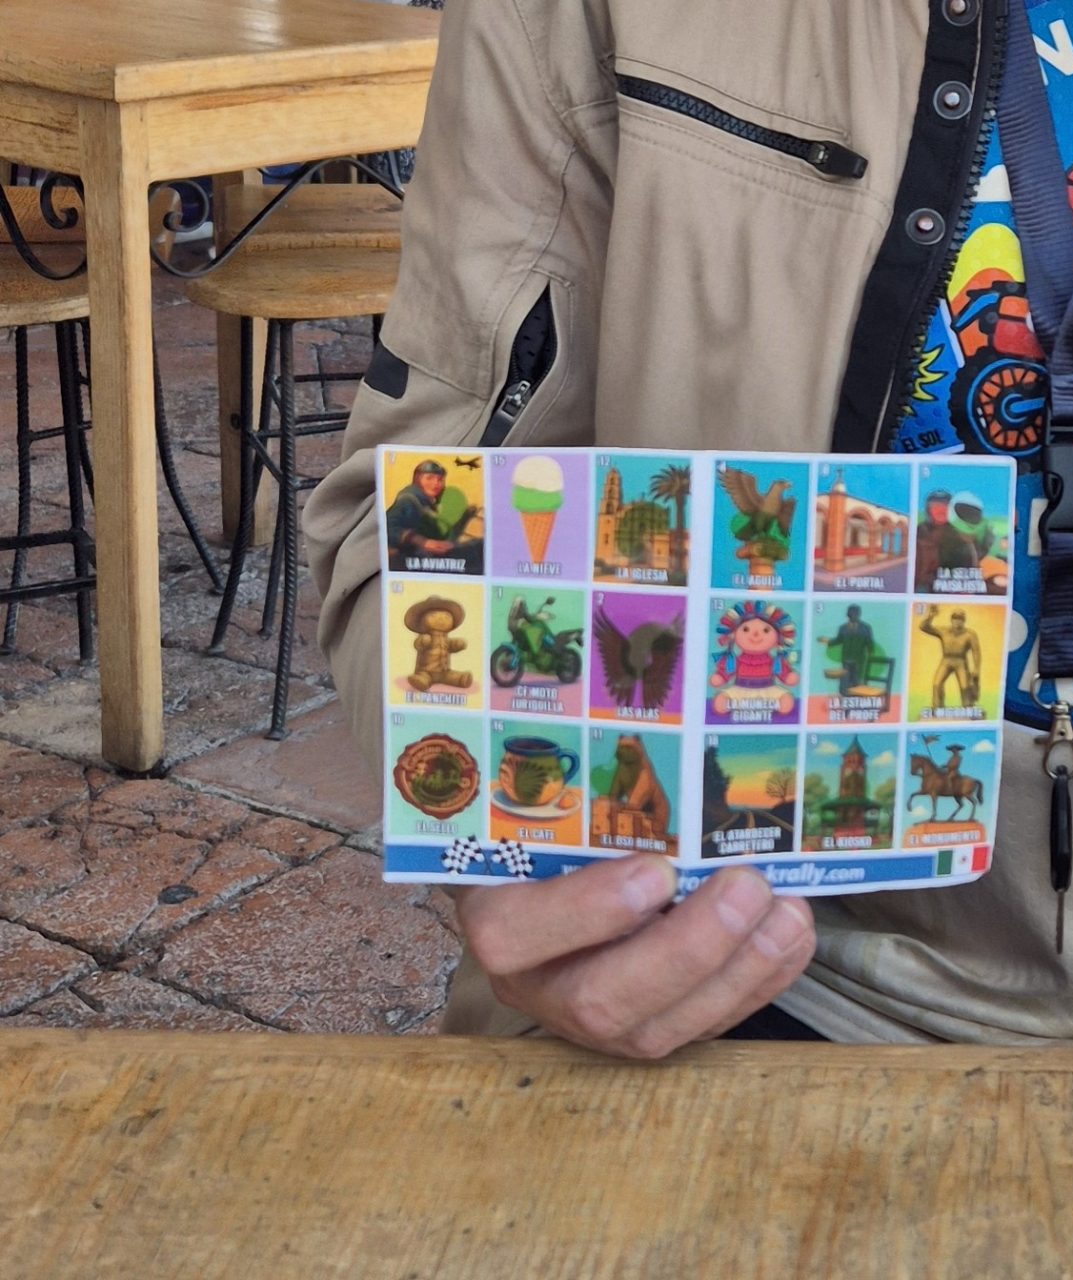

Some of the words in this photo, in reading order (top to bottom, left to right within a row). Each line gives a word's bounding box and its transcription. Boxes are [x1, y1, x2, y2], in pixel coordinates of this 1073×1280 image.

[901, 436, 918, 452] EL
[918, 430, 945, 448] SOL
[406, 557, 420, 570] LA
[421, 558, 466, 572] AVIATRIZ
[517, 563, 530, 573] LA
[532, 563, 561, 575] NIEVE
[617, 567, 629, 579] LA
[632, 569, 668, 582] IGLESIA
[937, 567, 951, 578] LA
[733, 575, 745, 585] EL
[836, 577, 846, 588] EL
[849, 577, 884, 589] PORTAL
[712, 599, 724, 610] 13
[529, 686, 558, 699] MOTO
[617, 706, 633, 717] LAS
[634, 707, 660, 720] ALAS
[732, 710, 773, 722] GIGANTE
[829, 709, 846, 721] DEL
[519, 828, 530, 839] EL
[602, 834, 613, 845] EL
[712, 831, 726, 843] EL
[823, 837, 834, 848] EL
